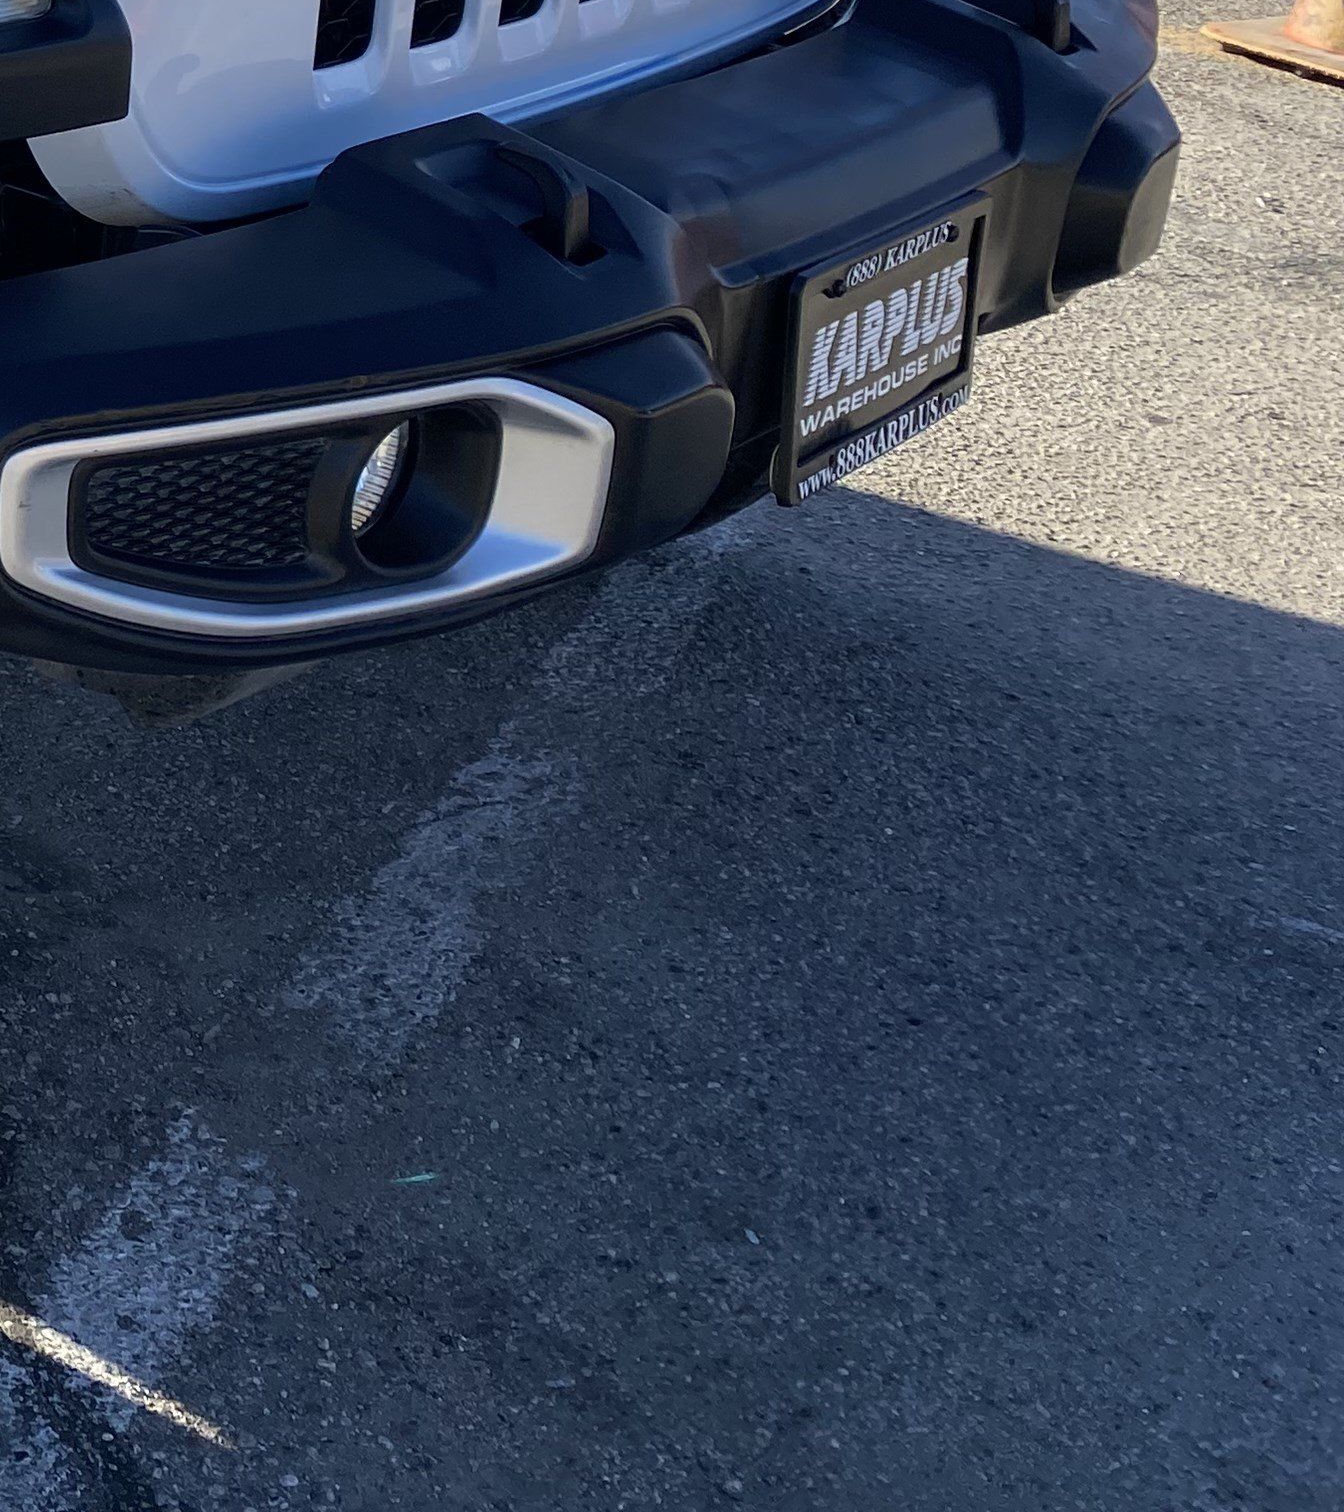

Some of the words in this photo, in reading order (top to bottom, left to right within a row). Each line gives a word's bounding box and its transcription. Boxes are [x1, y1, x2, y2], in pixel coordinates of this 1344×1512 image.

[845, 254, 883, 290] (888)
[883, 220, 952, 273] KARPLUS
[803, 257, 969, 407] KARPLUS
[800, 353, 929, 436] WAREHOUSE
